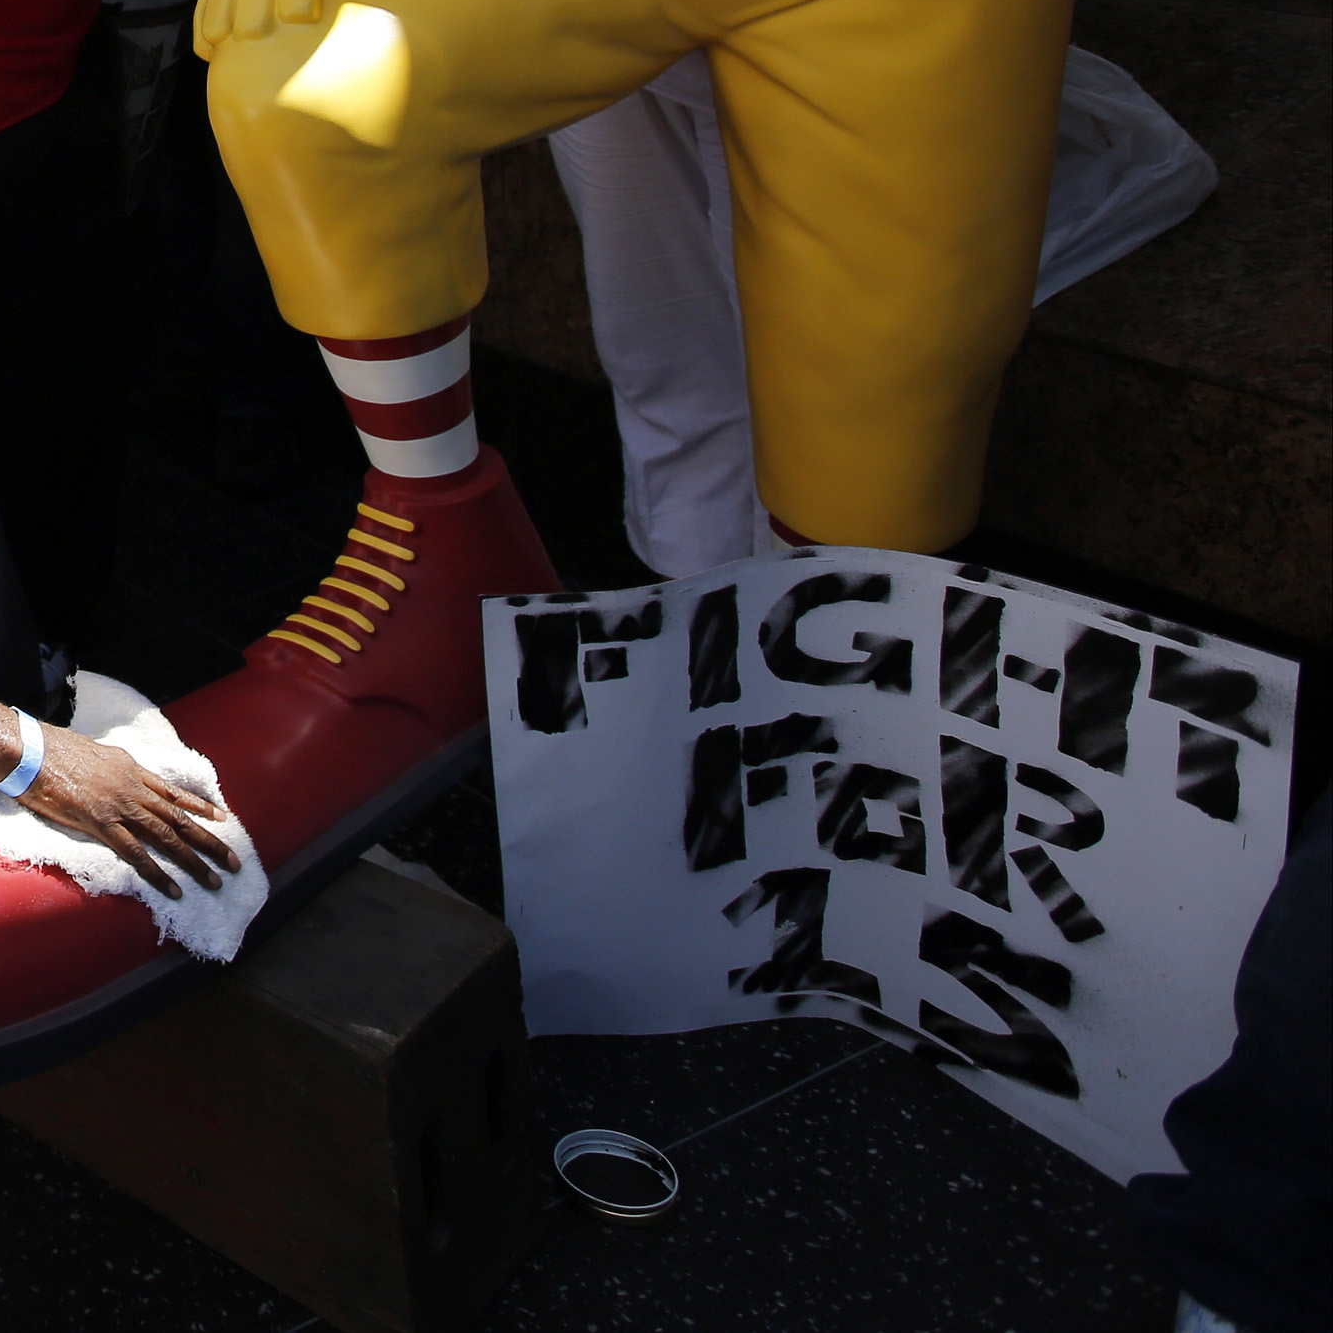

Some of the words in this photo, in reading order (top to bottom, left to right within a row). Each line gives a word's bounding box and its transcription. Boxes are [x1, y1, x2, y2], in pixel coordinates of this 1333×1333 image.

[514, 572, 1272, 823] FIGHT
[684, 714, 1106, 943] FOR
[723, 866, 1080, 1100] 15
